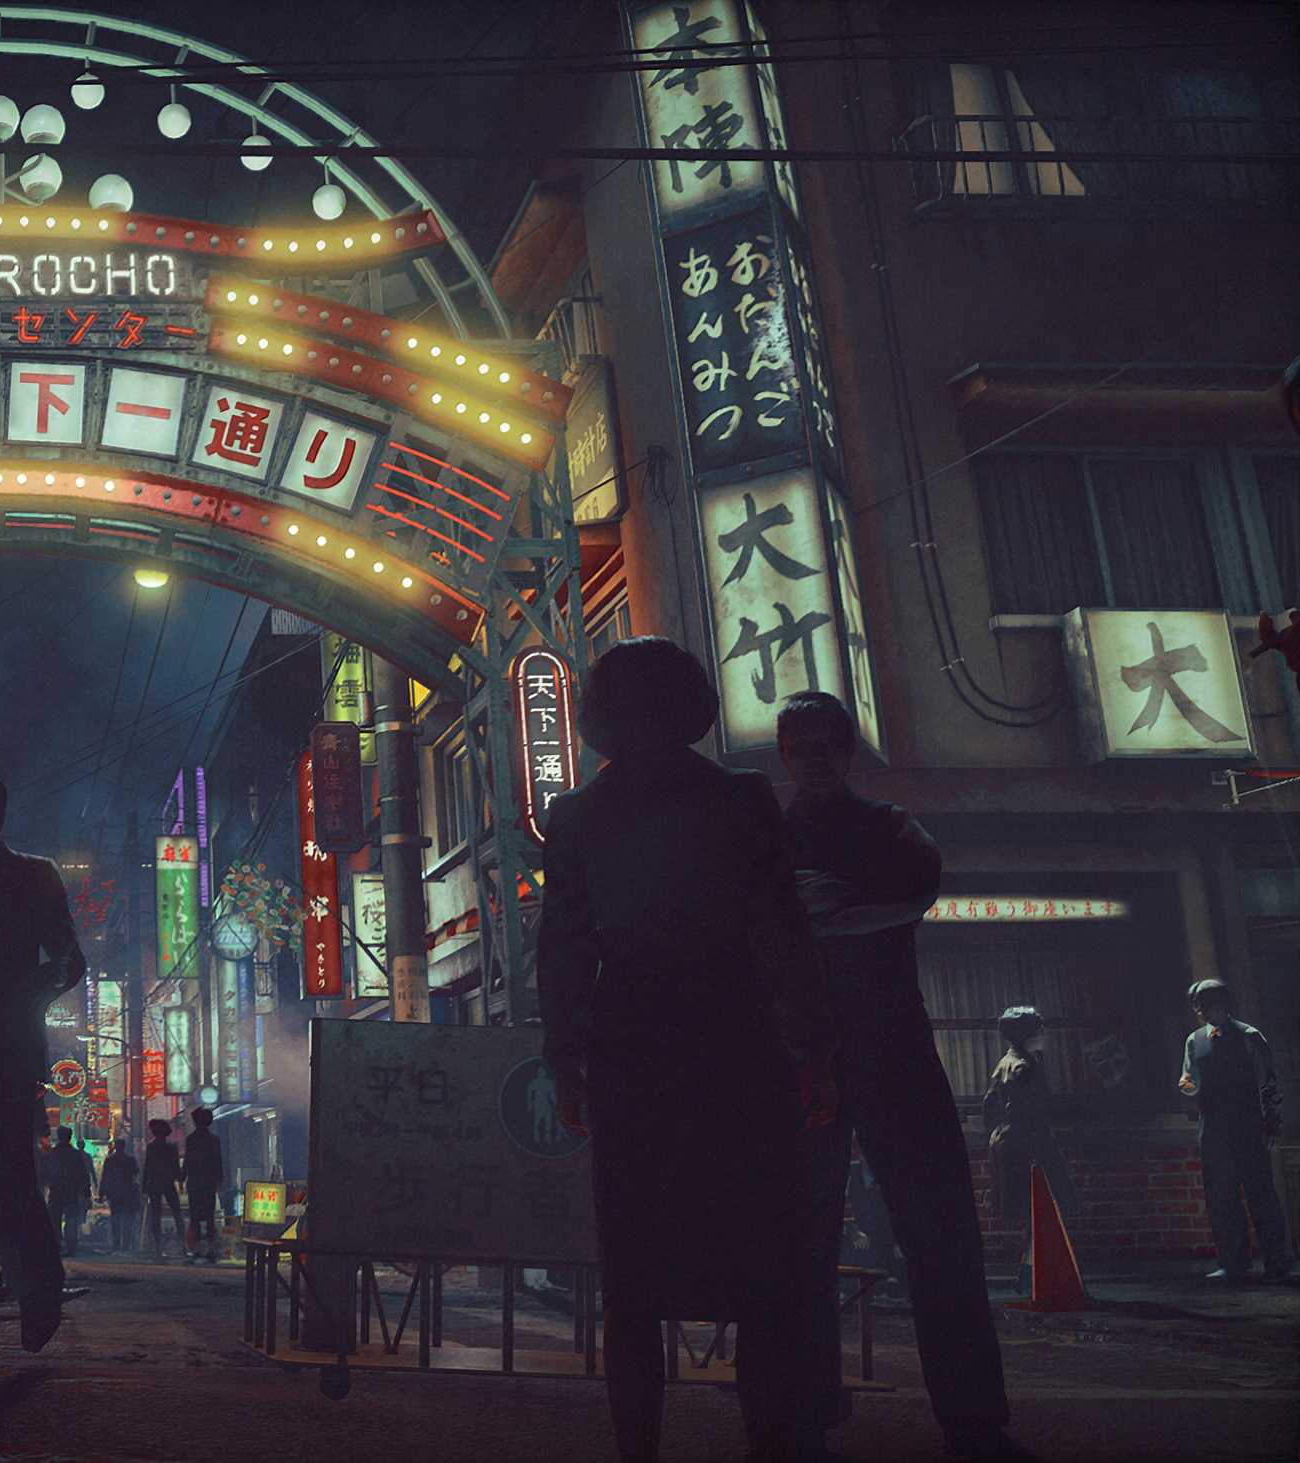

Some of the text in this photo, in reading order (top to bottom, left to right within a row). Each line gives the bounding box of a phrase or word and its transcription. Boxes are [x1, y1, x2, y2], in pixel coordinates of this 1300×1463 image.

[647, 8, 752, 193] 本陣
[680, 247, 741, 440] あんみつ
[719, 491, 833, 704] 大竹
[1119, 622, 1246, 743] 大
